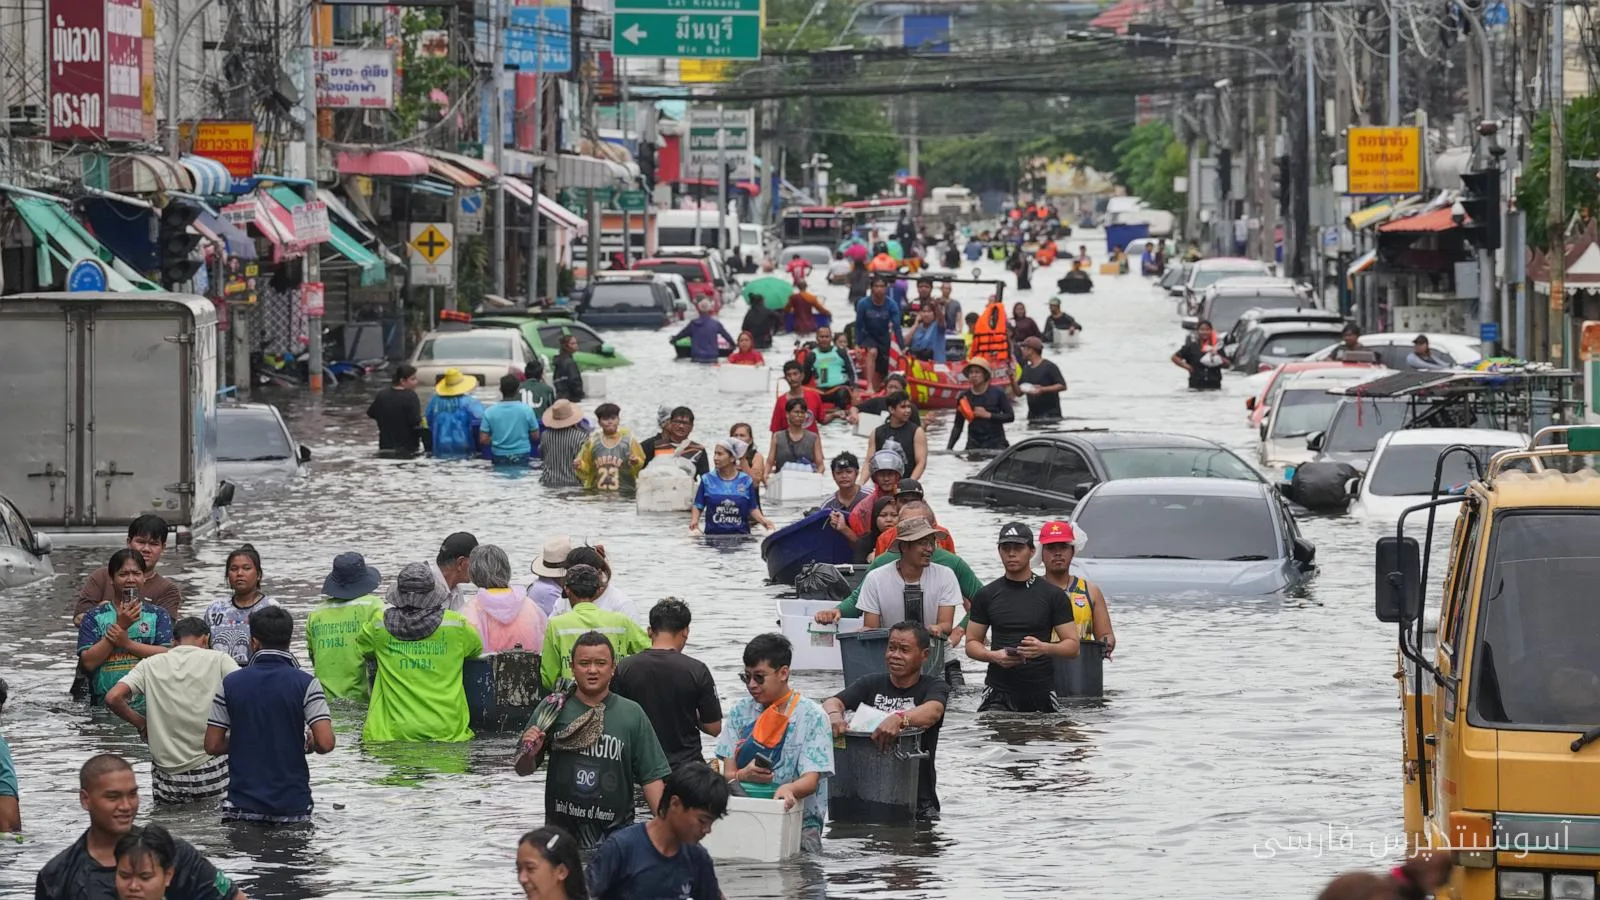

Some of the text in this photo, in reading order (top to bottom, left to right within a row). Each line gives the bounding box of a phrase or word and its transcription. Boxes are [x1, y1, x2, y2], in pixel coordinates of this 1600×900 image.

[675, 15, 734, 46] มีนบุรี
[53, 14, 101, 76] มุ้งลวด
[677, 45, 732, 55] Min Buri
[331, 67, 353, 77] DVD
[53, 92, 101, 128] กระจก
[597, 466, 620, 490] 23
[712, 513, 742, 526] Chang
[210, 613, 224, 626] 30
[317, 636, 349, 649] กทม.
[399, 657, 436, 670] กทม.
[575, 769, 596, 787] DC
[568, 802, 586, 818] States
[587, 805, 595, 819] of
[594, 806, 616, 821] America
